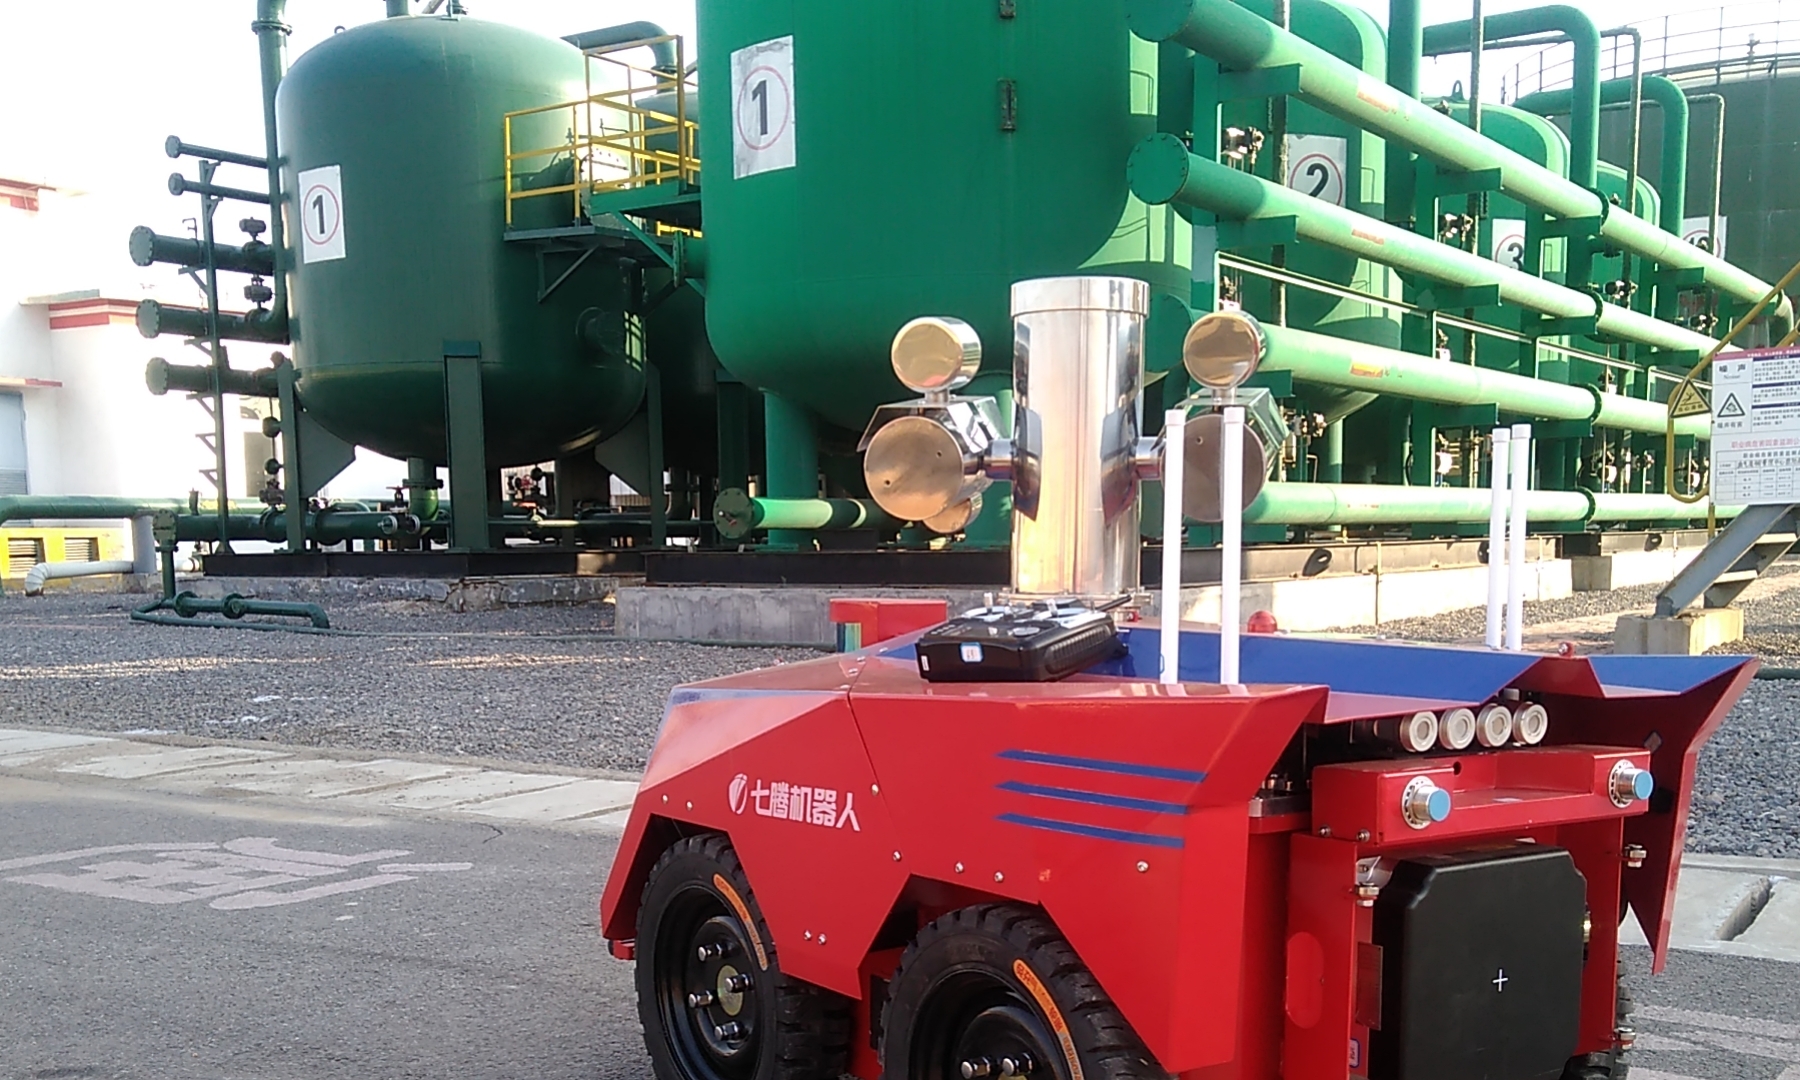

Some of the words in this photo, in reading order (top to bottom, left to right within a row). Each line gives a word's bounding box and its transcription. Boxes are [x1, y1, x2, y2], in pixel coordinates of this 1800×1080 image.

[751, 79, 768, 136] 1
[1306, 162, 1329, 198] 2
[312, 194, 325, 235] 1
[1507, 242, 1524, 271] 3
[750, 779, 861, 832] 七腾机器人
